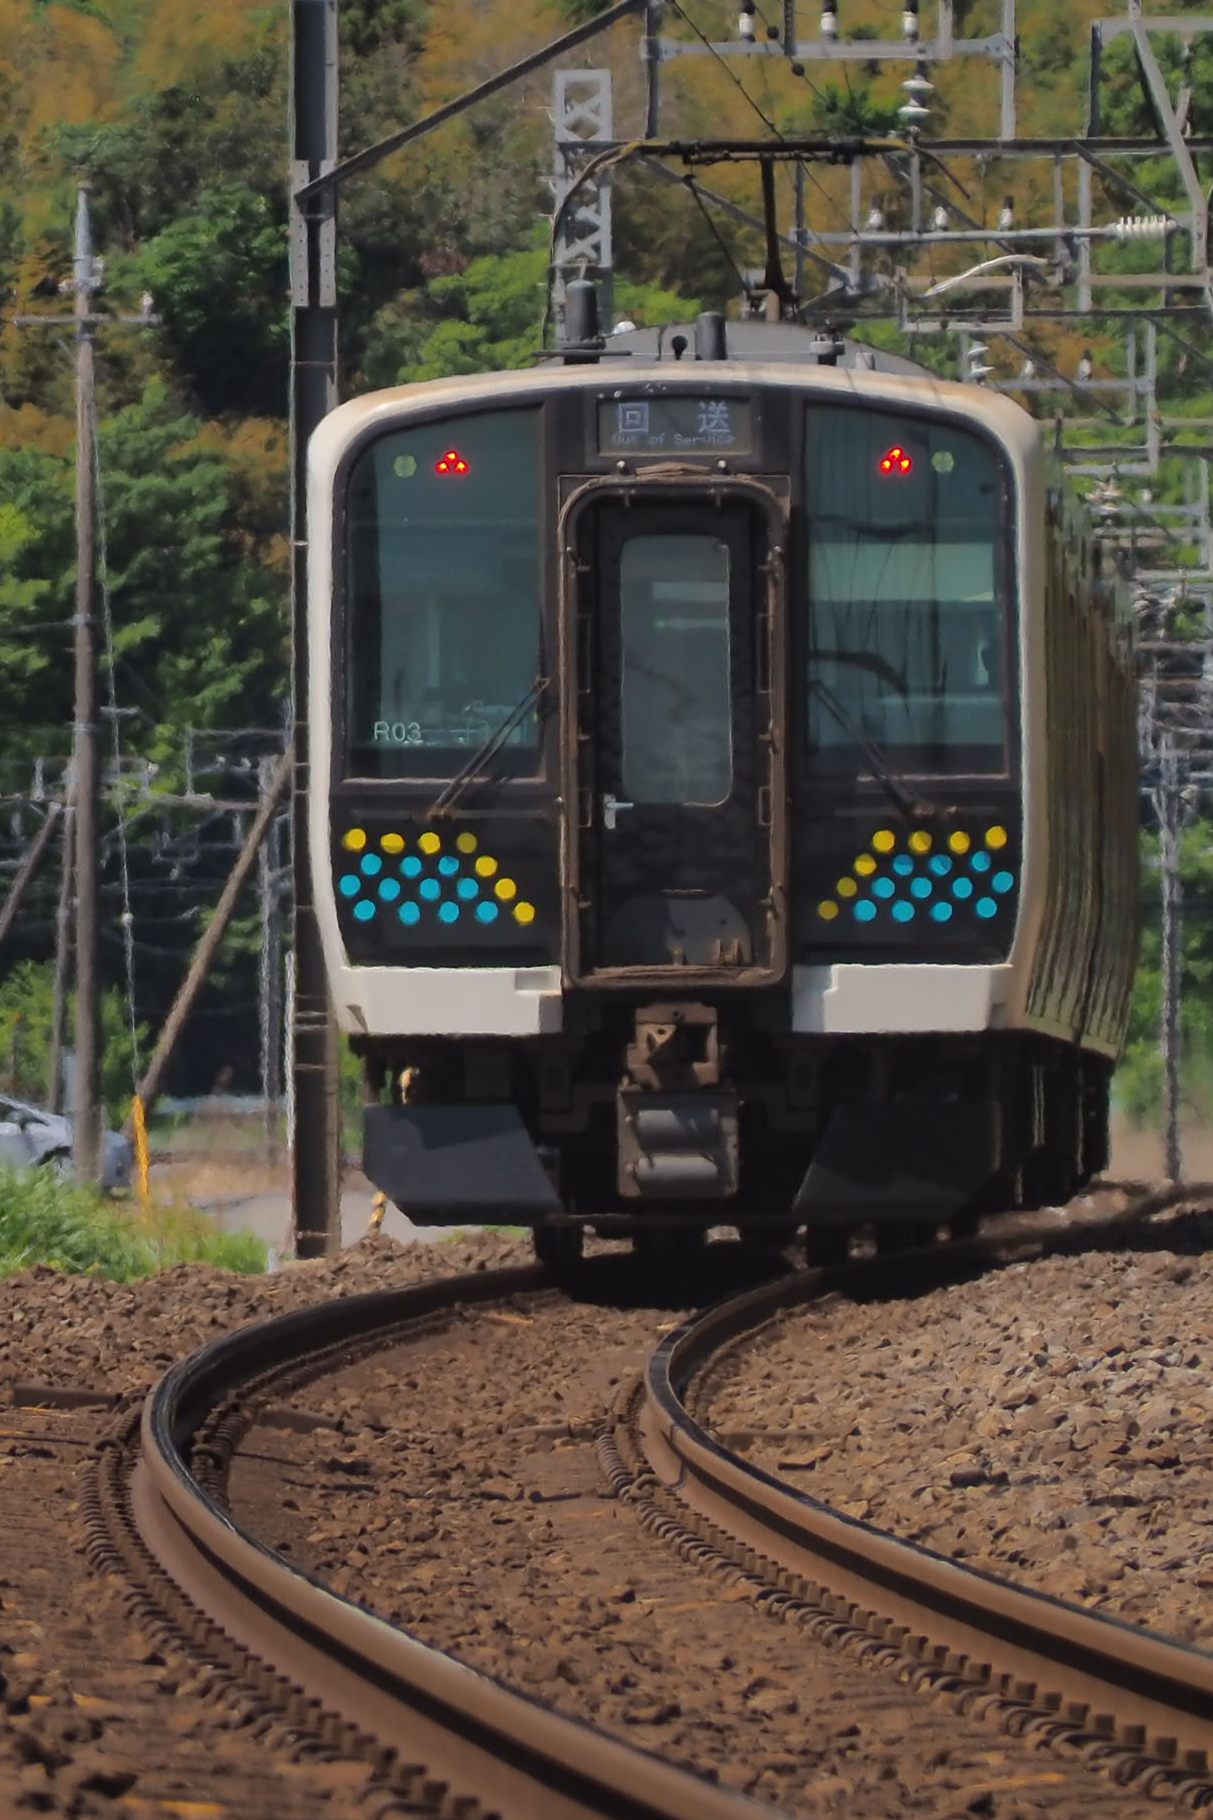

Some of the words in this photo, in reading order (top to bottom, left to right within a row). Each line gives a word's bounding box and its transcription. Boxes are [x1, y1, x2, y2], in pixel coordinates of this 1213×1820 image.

[617, 401, 731, 433] 回送
[612, 432, 638, 446] Out
[649, 432, 667, 446] of
[673, 432, 737, 446] Service
[373, 721, 422, 742] R03
